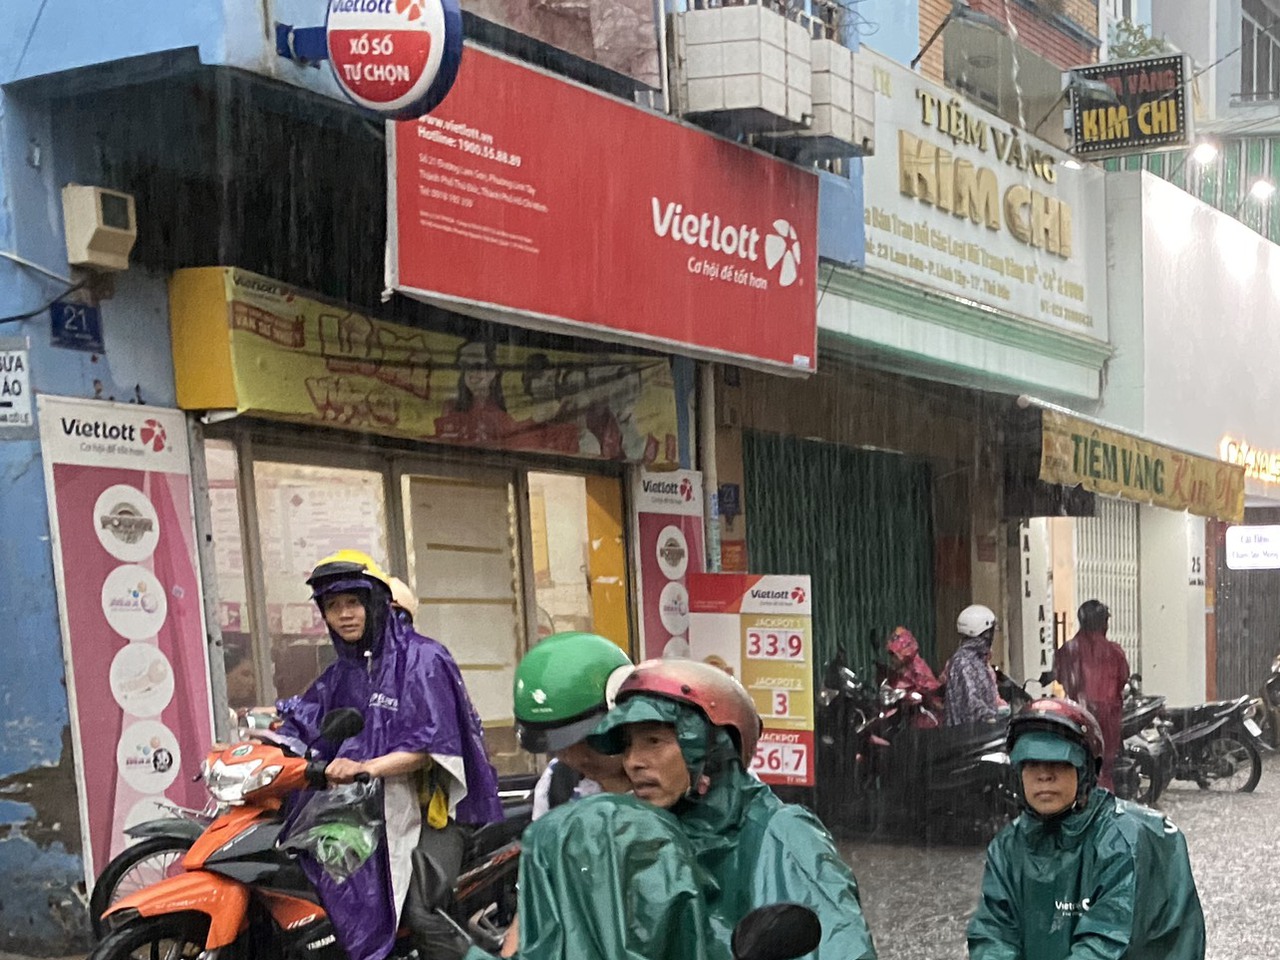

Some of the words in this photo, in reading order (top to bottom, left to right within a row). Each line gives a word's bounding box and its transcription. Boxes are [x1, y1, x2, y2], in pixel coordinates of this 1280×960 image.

[364, 64, 410, 86] CHỌN
[1082, 104, 1130, 143] KIM
[1138, 99, 1177, 135] CHI
[916, 88, 988, 153] TIỆM
[990, 127, 1057, 184] VÀNG
[899, 129, 1000, 231] KIM
[1003, 184, 1072, 260] CHI
[652, 196, 760, 262] Vietlott
[64, 305, 87, 331] 21
[61, 417, 135, 441] Vietlott
[1071, 429, 1118, 489] TIỆM
[1122, 441, 1165, 495] VÀNG
[642, 480, 678, 495] Vietlott
[1192, 556, 1201, 573] 25
[751, 590, 789, 599] Vietlott
[755, 618, 793, 628] JACKPOT
[756, 677, 794, 687] JACKPOT
[775, 693, 788, 715] 3
[760, 733, 800, 743] JACKPOT
[307, 934, 336, 951] YAMAHA
